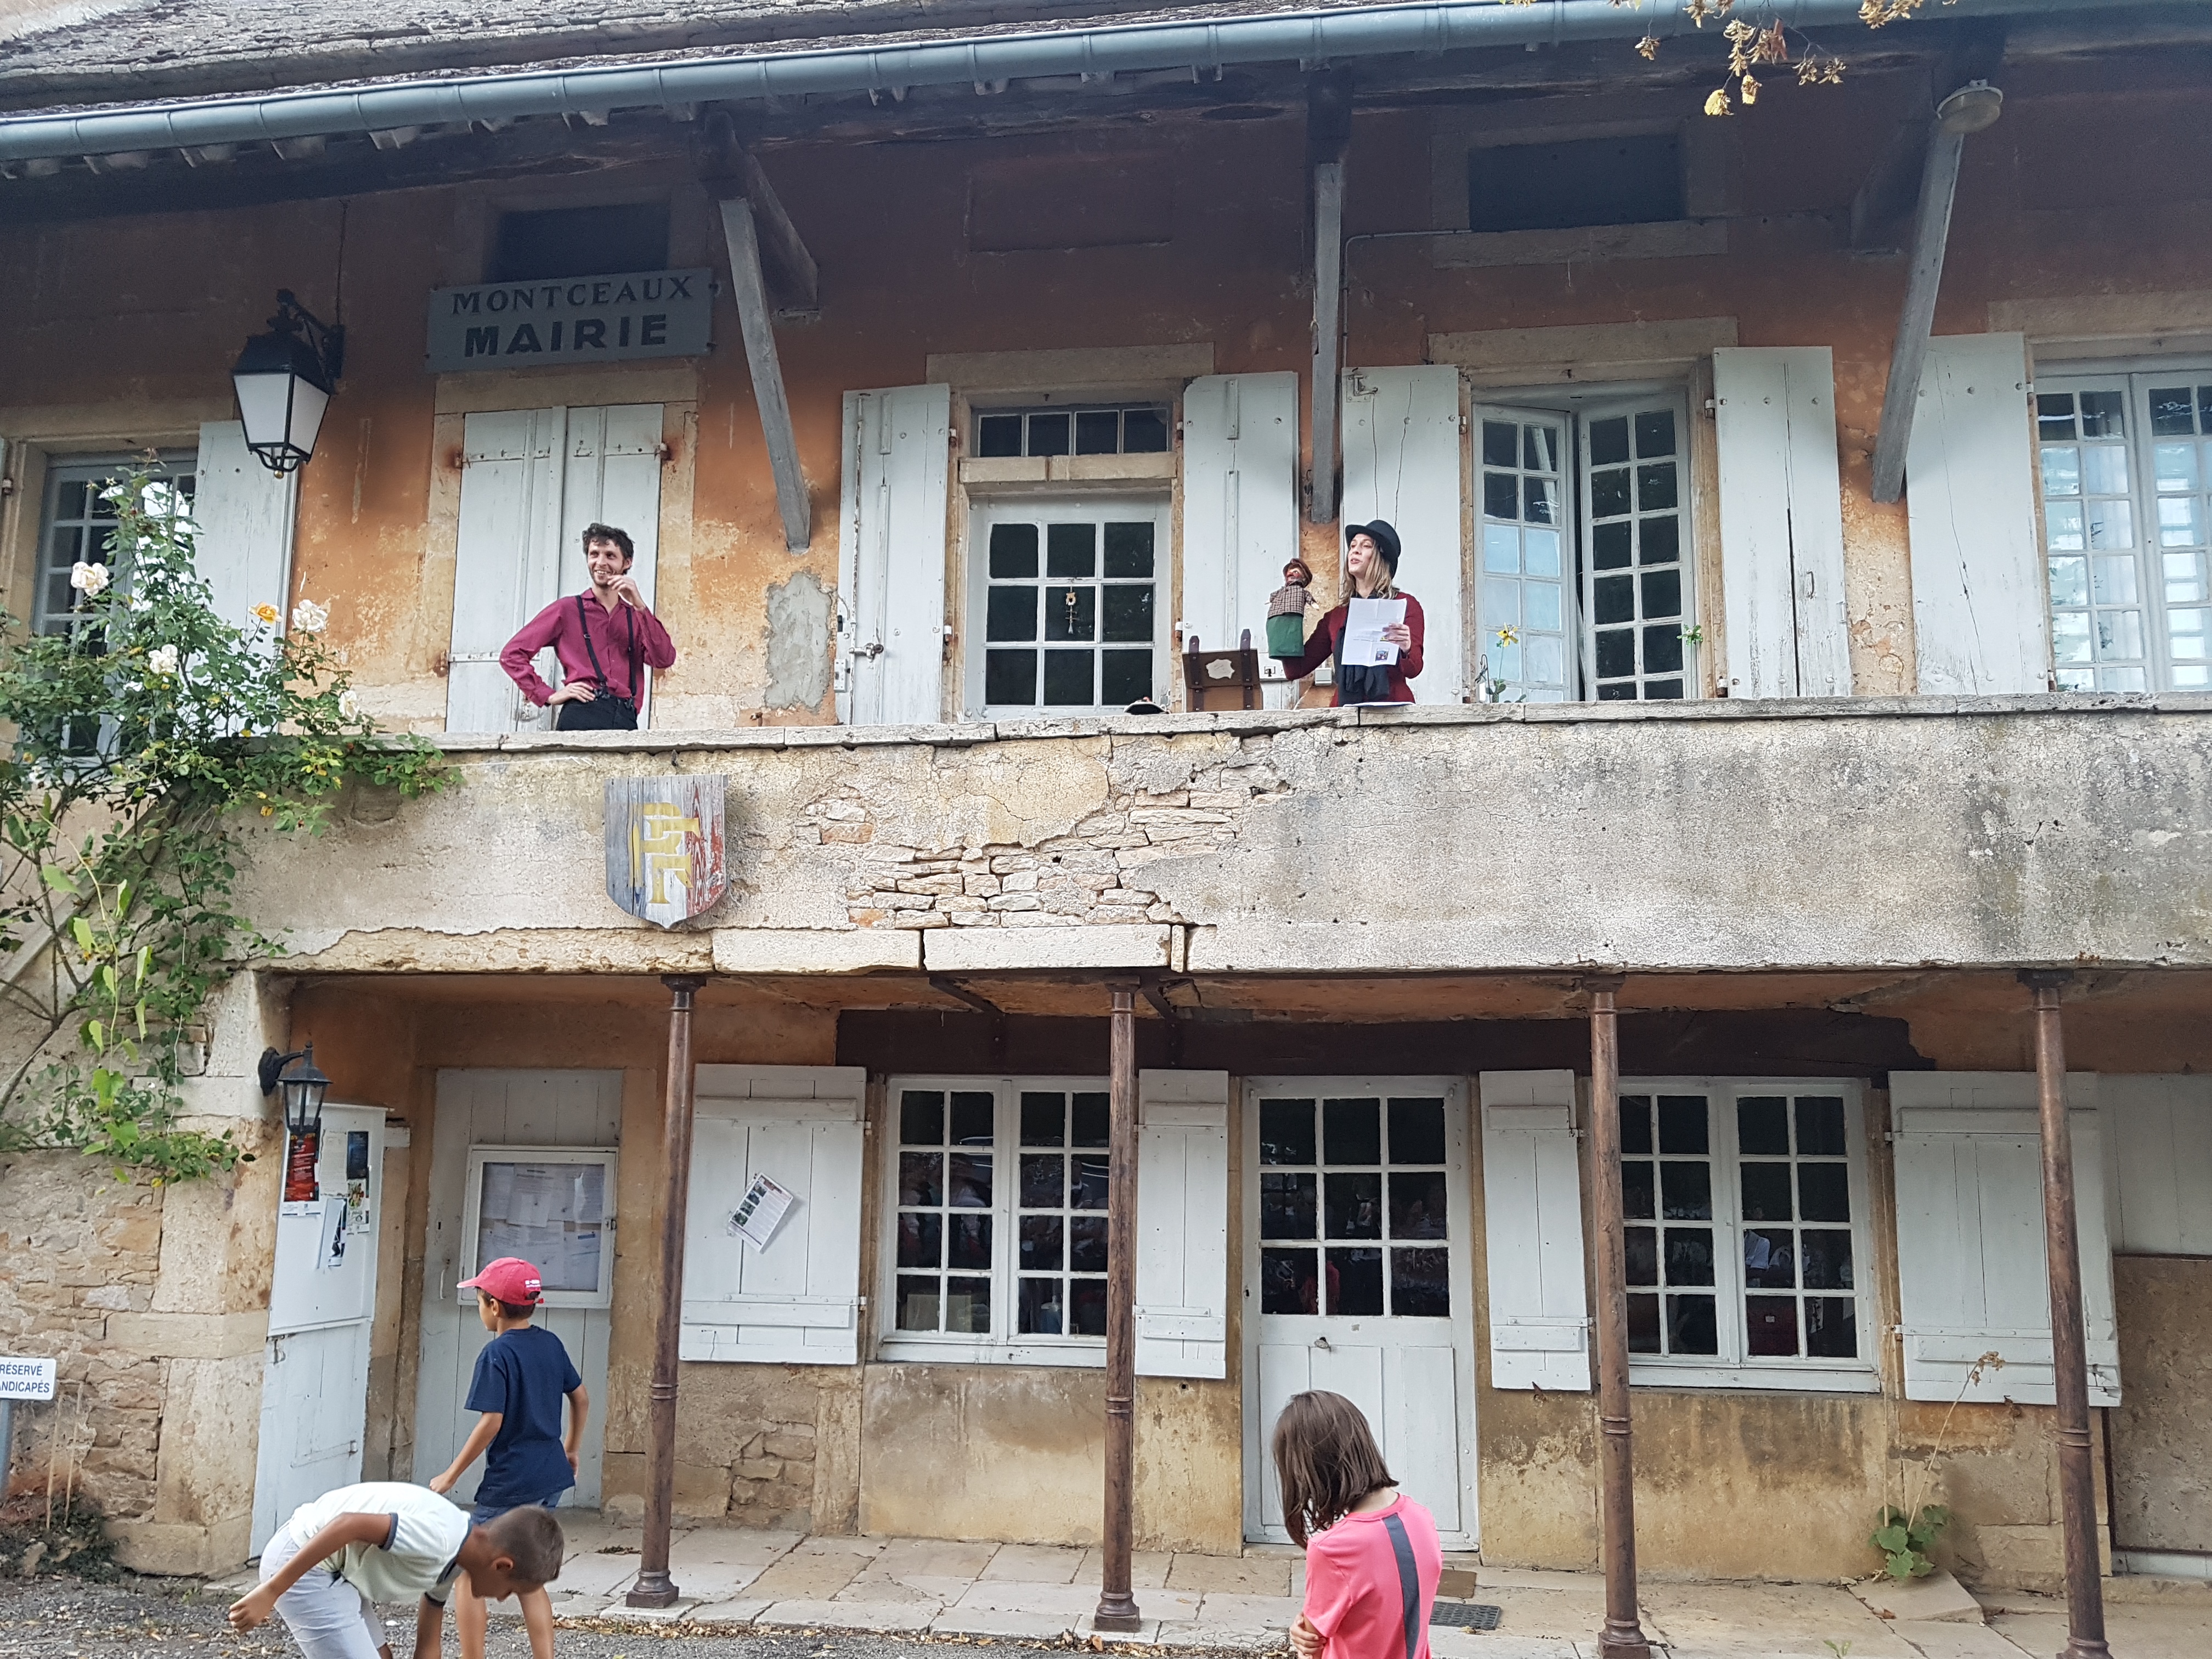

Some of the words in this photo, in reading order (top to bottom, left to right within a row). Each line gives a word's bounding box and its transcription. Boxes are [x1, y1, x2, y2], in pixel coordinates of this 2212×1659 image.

[452, 276, 692, 314] MONTCEAUX
[464, 314, 667, 358] MAIRIE
[0, 1362, 43, 1376] RÉSERVÉ
[0, 1380, 50, 1393] NDICAPÉS
